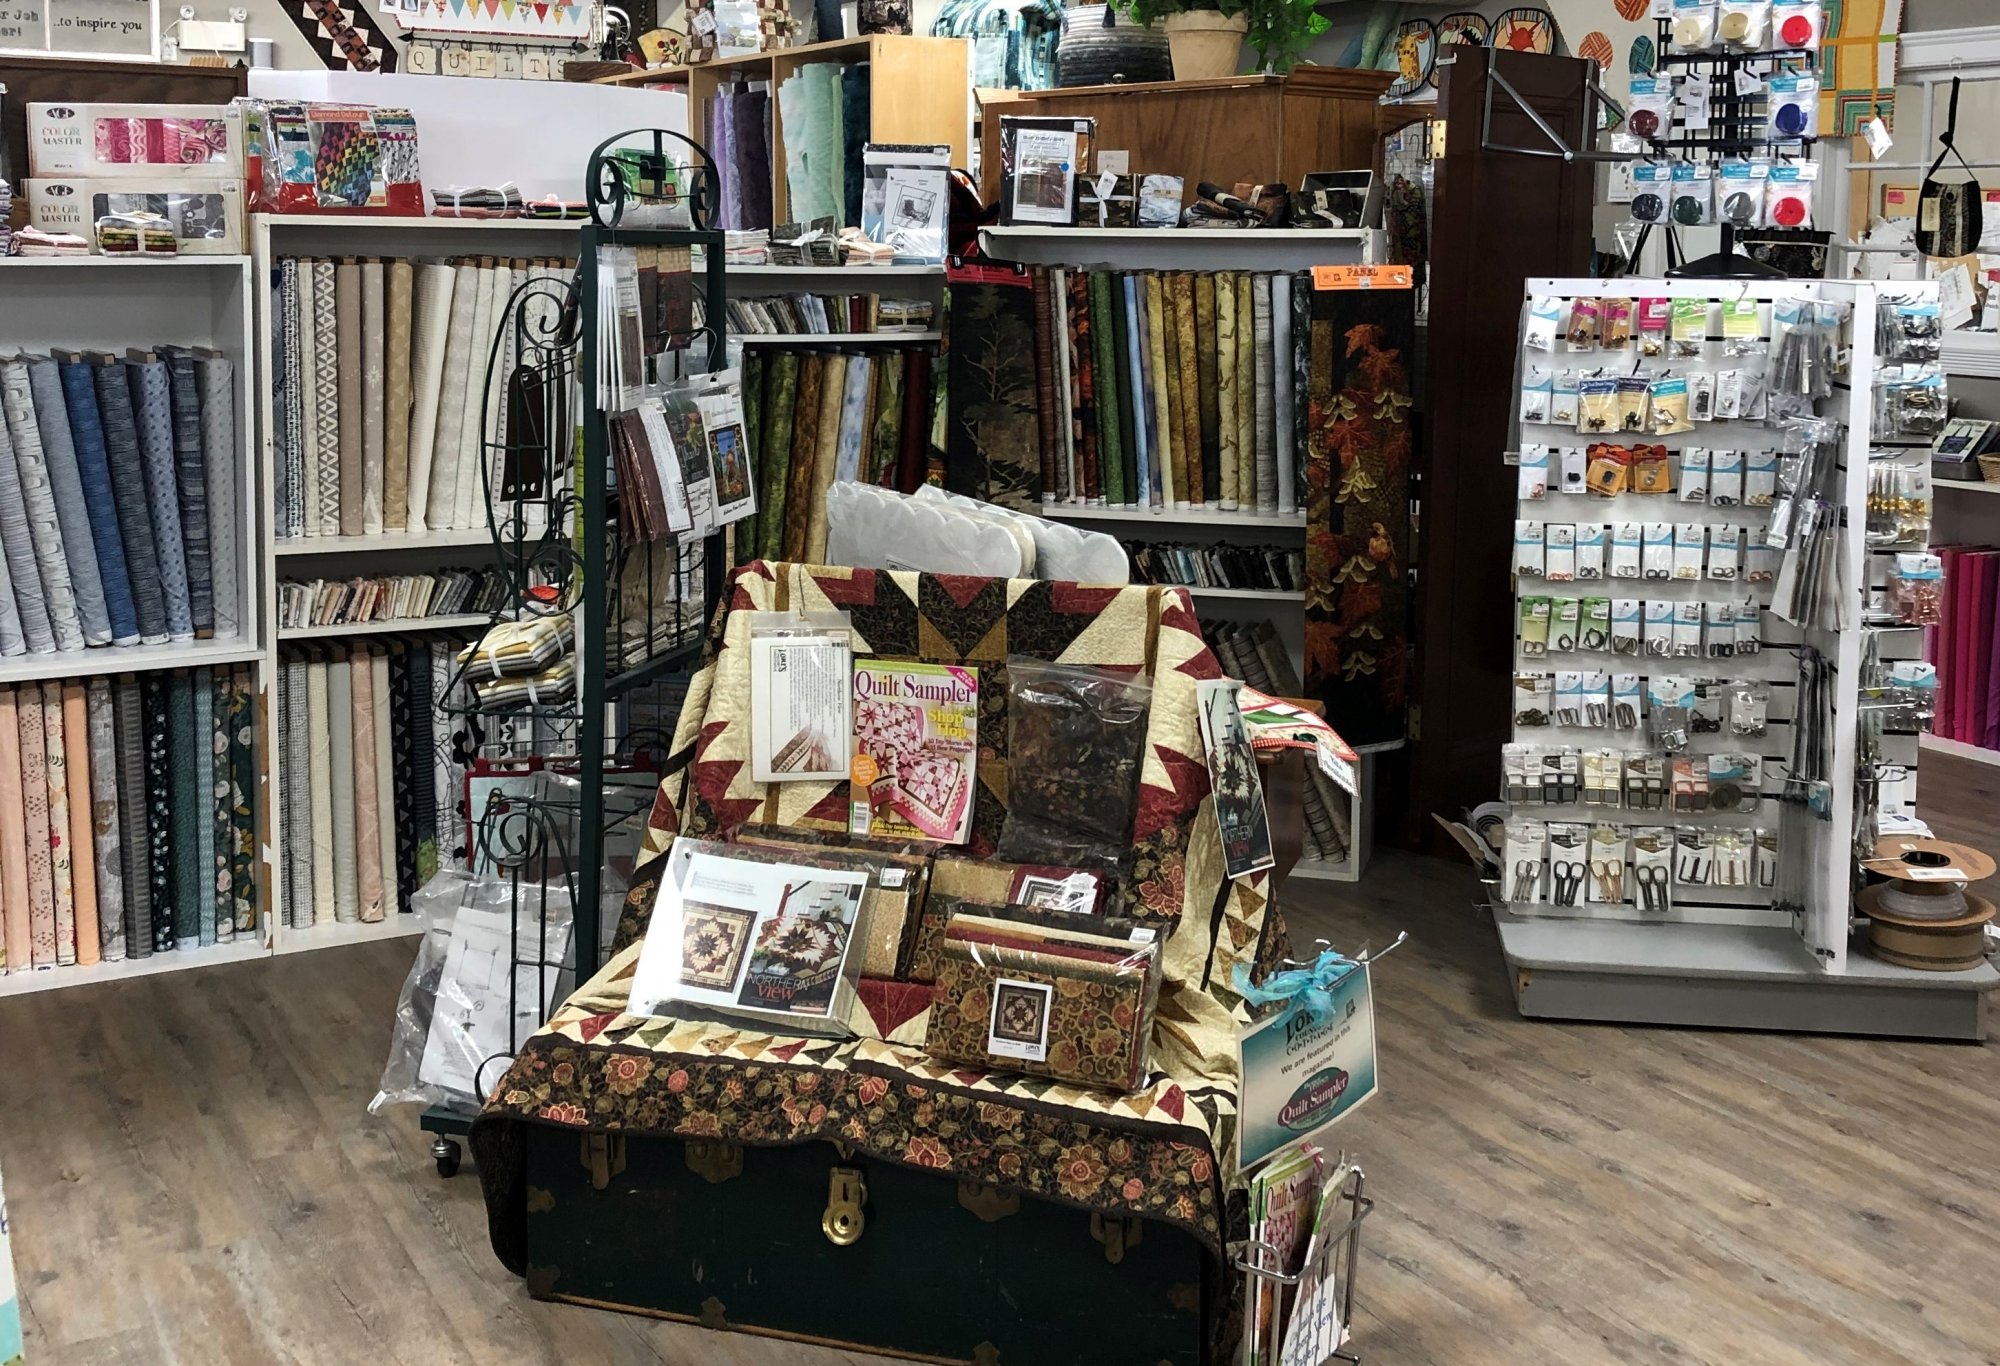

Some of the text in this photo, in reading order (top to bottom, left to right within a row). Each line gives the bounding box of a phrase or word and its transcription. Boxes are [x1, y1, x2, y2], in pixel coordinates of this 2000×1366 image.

[76, 16, 117, 32] inspire
[120, 21, 142, 34] you
[310, 110, 340, 119] Diamond
[41, 215, 80, 223] MASTER
[855, 670, 899, 700] Quilt
[903, 674, 972, 706] Sampler
[928, 708, 964, 727] Shop
[937, 723, 968, 740] Hop
[746, 973, 808, 991] NORTHERN
[758, 985, 794, 1001] view
[1280, 1064, 1293, 1075] We
[1294, 1057, 1305, 1066] are
[1306, 1040, 1334, 1061] featured
[1341, 1025, 1351, 1038] this
[1302, 1051, 1335, 1077] magazine!
[1281, 1099, 1309, 1124] Quilt
[1310, 1077, 1348, 1108] Sampler
[1266, 1182, 1288, 1221] Quilt
